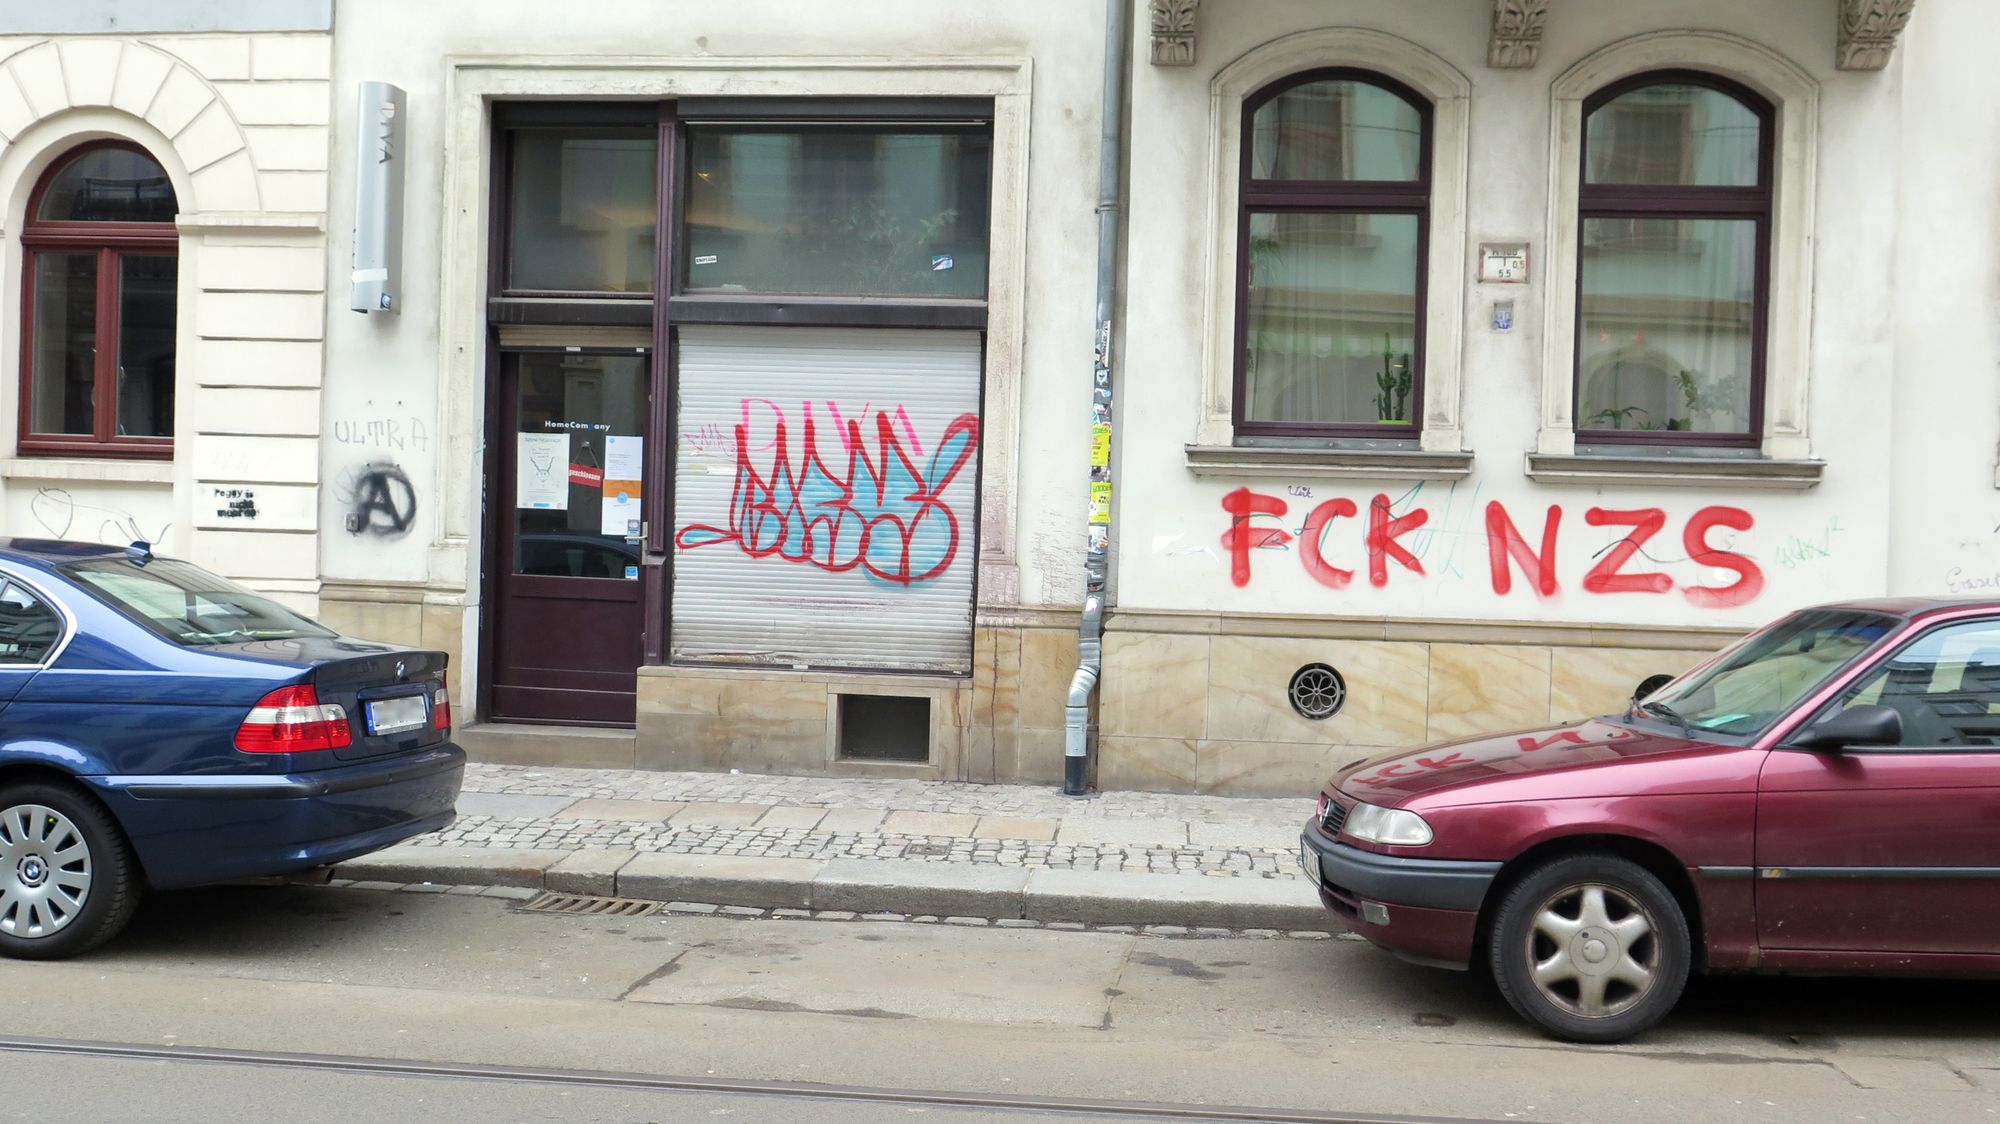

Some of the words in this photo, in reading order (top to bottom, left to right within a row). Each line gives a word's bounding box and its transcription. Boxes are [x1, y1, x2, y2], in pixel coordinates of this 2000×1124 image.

[379, 102, 395, 164] DIVA
[334, 416, 430, 452] ULTRA
[740, 398, 924, 456] DIVA
[1221, 486, 1429, 590] FCK
[1485, 499, 1765, 609] NZS
